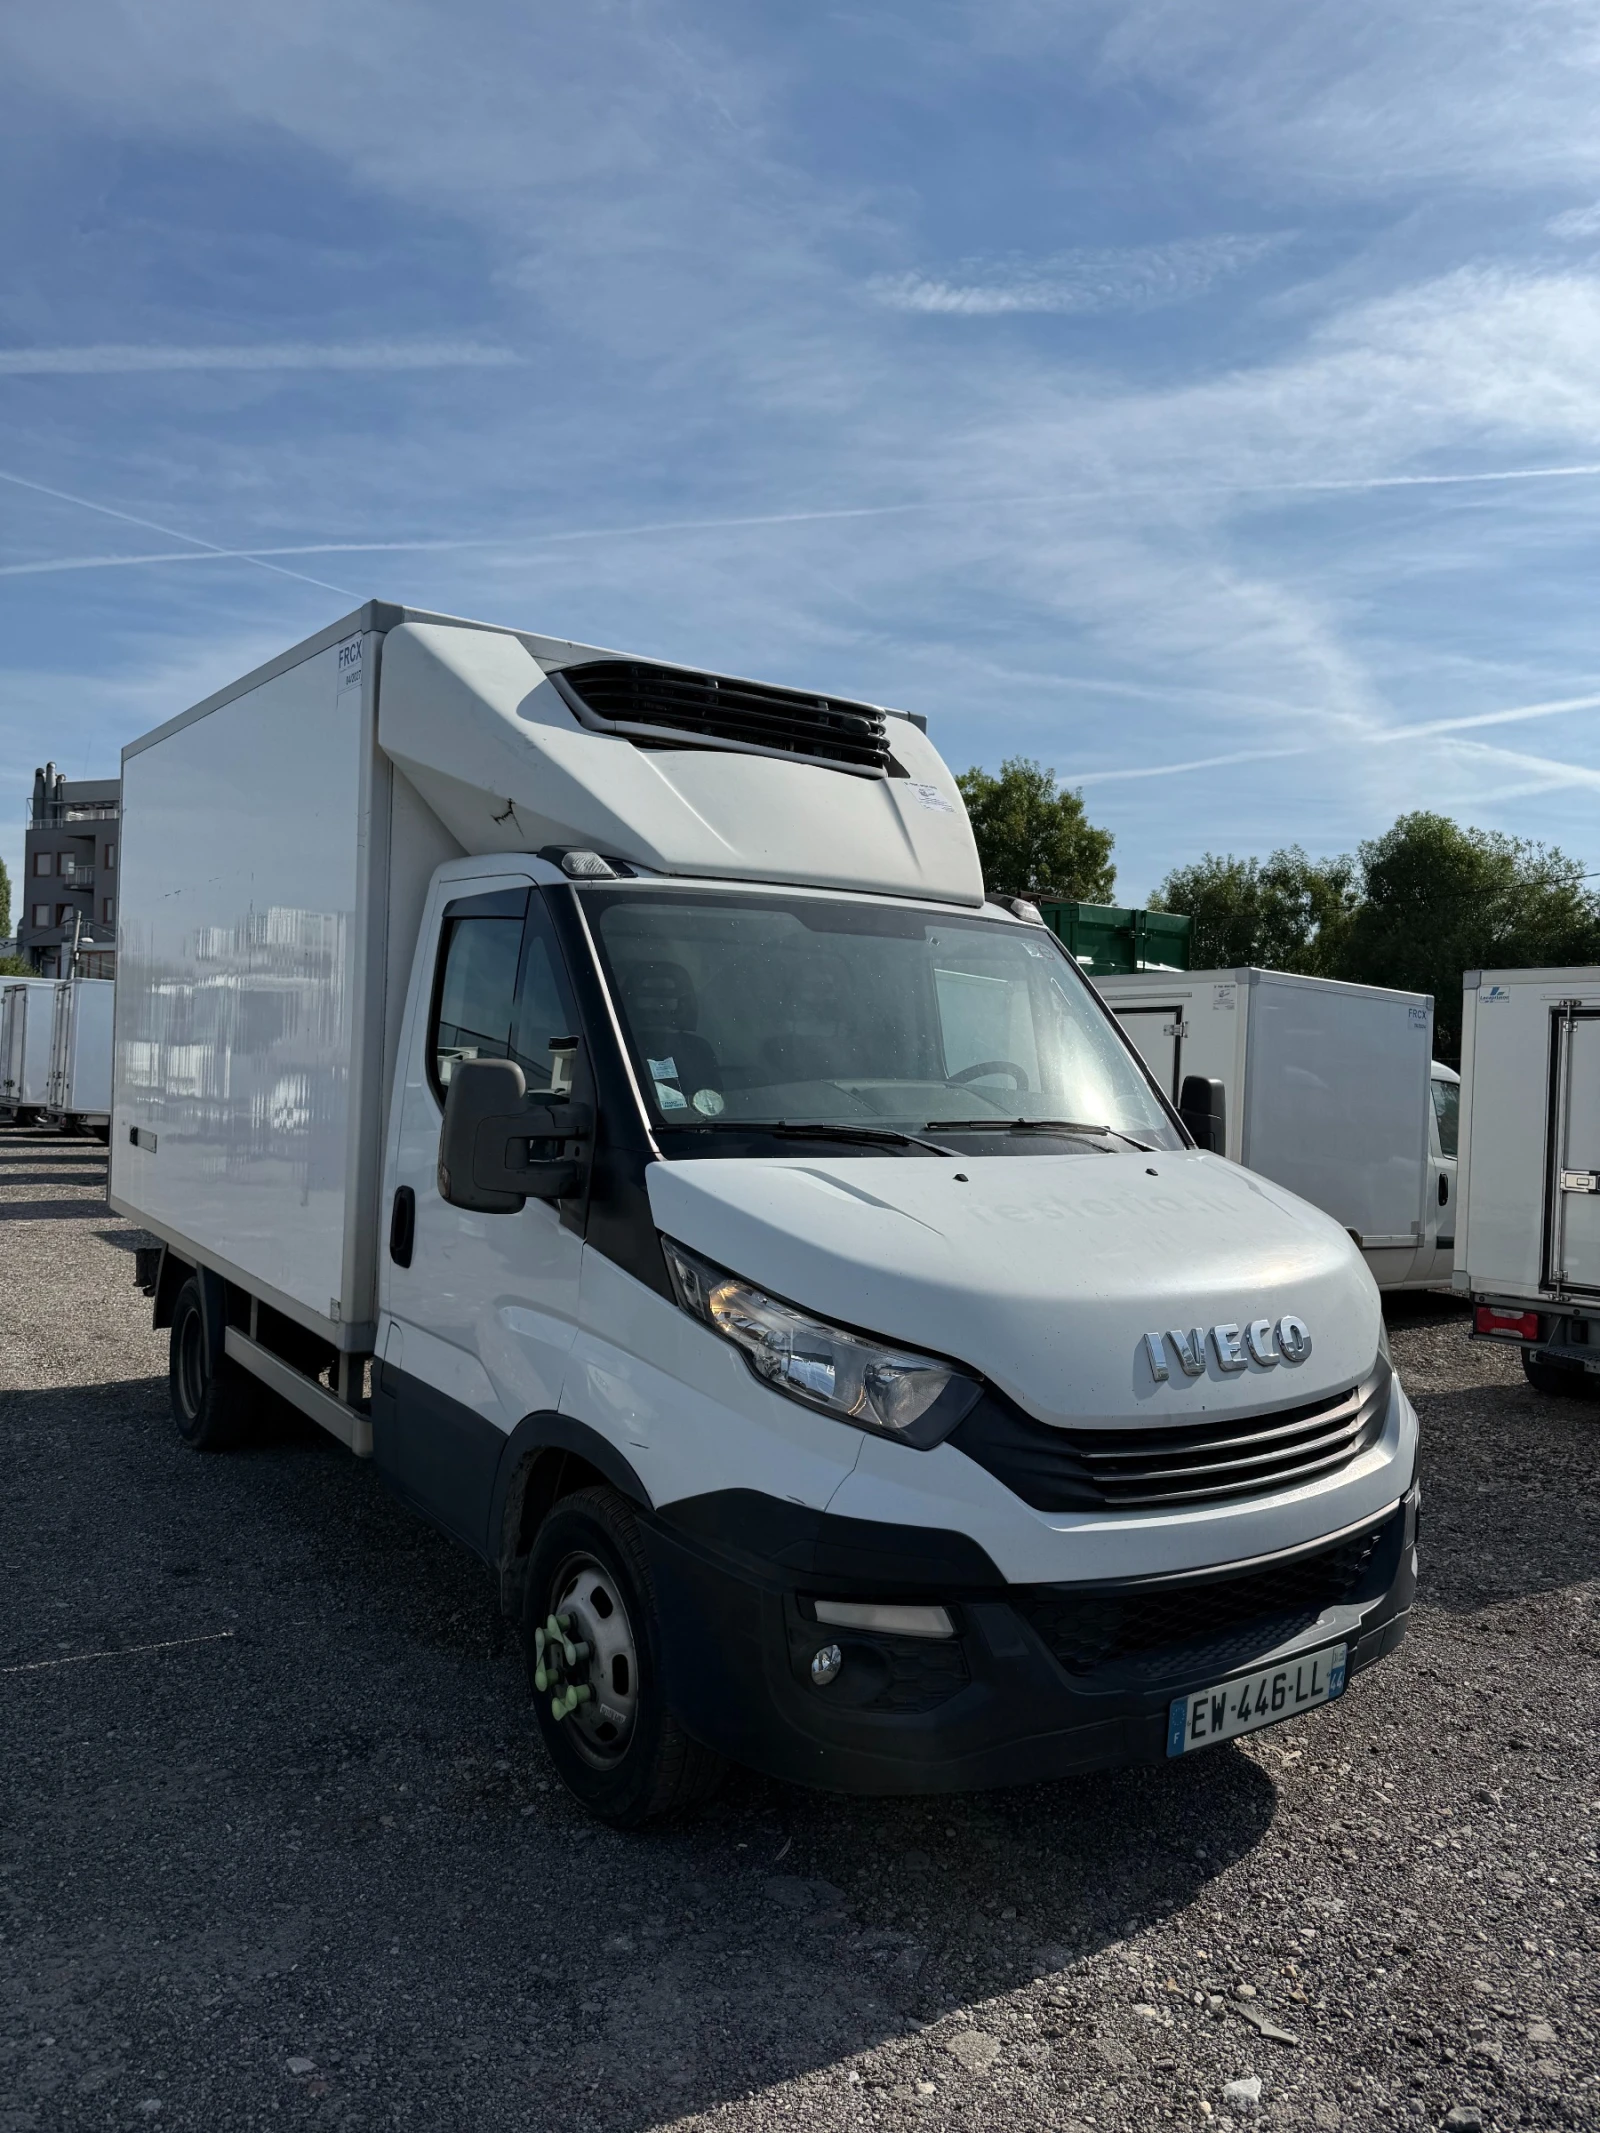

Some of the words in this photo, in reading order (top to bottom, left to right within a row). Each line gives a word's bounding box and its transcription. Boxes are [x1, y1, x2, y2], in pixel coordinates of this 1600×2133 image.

[339, 640, 362, 668] FRCX
[1408, 1008, 1427, 1020] FRCX
[1144, 1315, 1313, 1382] IVECO
[1330, 1671, 1344, 1692] 44
[1173, 1731, 1181, 1745] F
